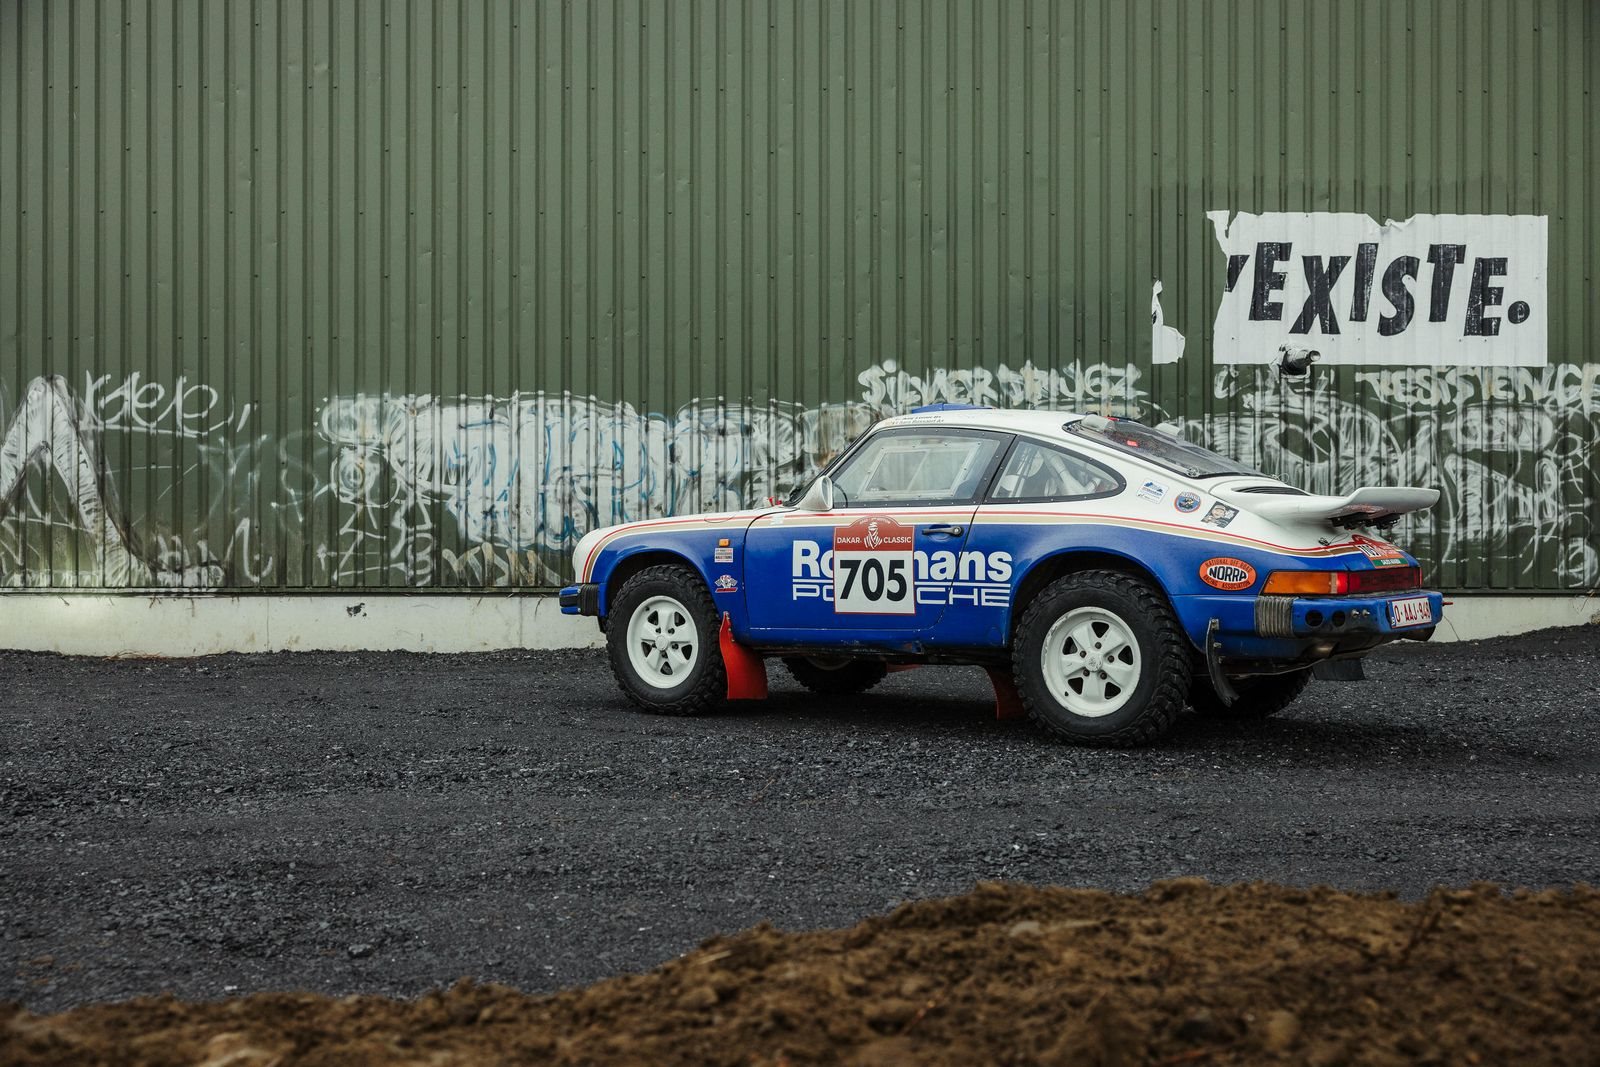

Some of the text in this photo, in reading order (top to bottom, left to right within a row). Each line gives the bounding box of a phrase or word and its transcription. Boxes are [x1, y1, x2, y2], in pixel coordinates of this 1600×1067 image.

[883, 536, 912, 544] CLASSIC
[840, 558, 907, 602] 705
[1209, 566, 1247, 582] NORRA
